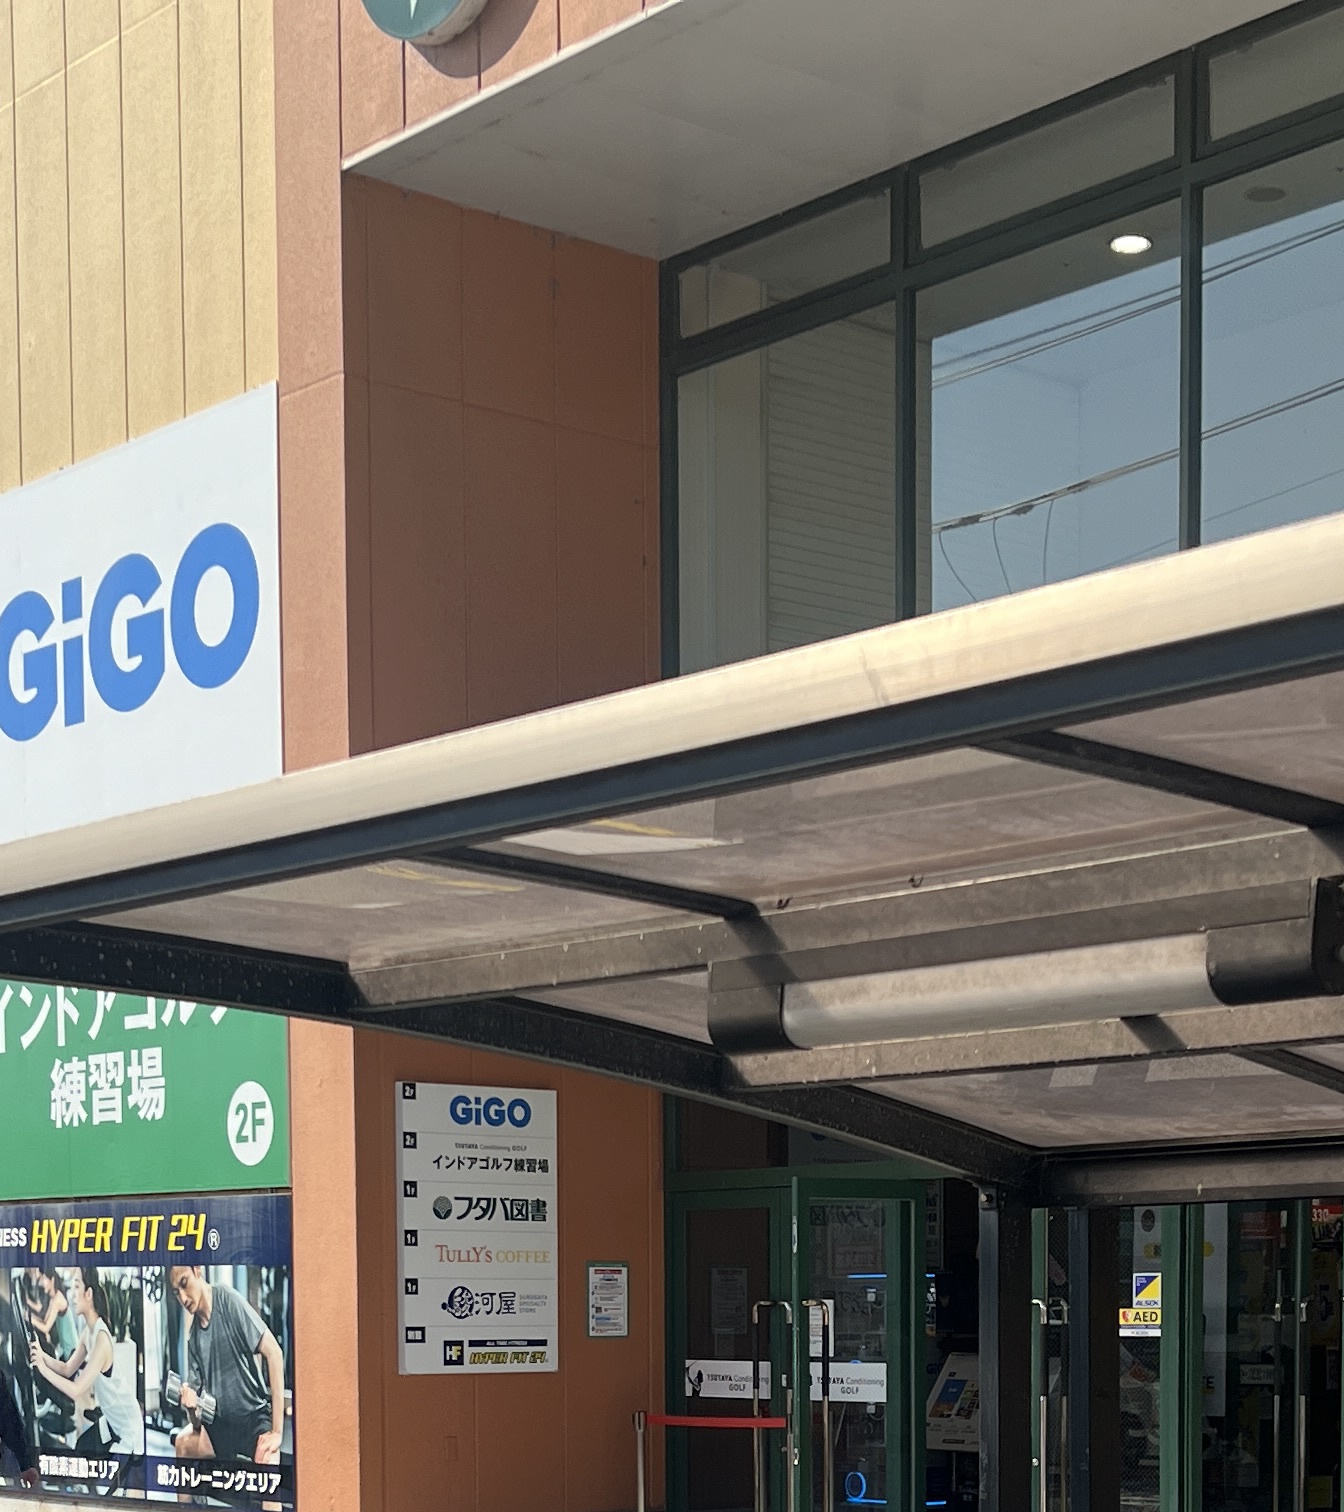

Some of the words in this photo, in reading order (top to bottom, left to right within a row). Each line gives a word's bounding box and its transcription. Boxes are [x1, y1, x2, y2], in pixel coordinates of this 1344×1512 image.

[49, 1046, 166, 1129] 練習場
[234, 1101, 268, 1144] 2F
[449, 1095, 532, 1128] GiGO
[432, 1154, 550, 1174] インドアゴルフ練習場
[453, 1196, 548, 1222] フタバ図書
[31, 1217, 115, 1254] HYPER
[120, 1214, 166, 1252] FIT
[167, 1213, 207, 1252] 24
[495, 1250, 551, 1264] COFFEE
[1133, 1311, 1158, 1323] AED
[39, 1454, 120, 1481] 有酸素運動エリア
[156, 1464, 282, 1495] 筋力トレーニングエリア
